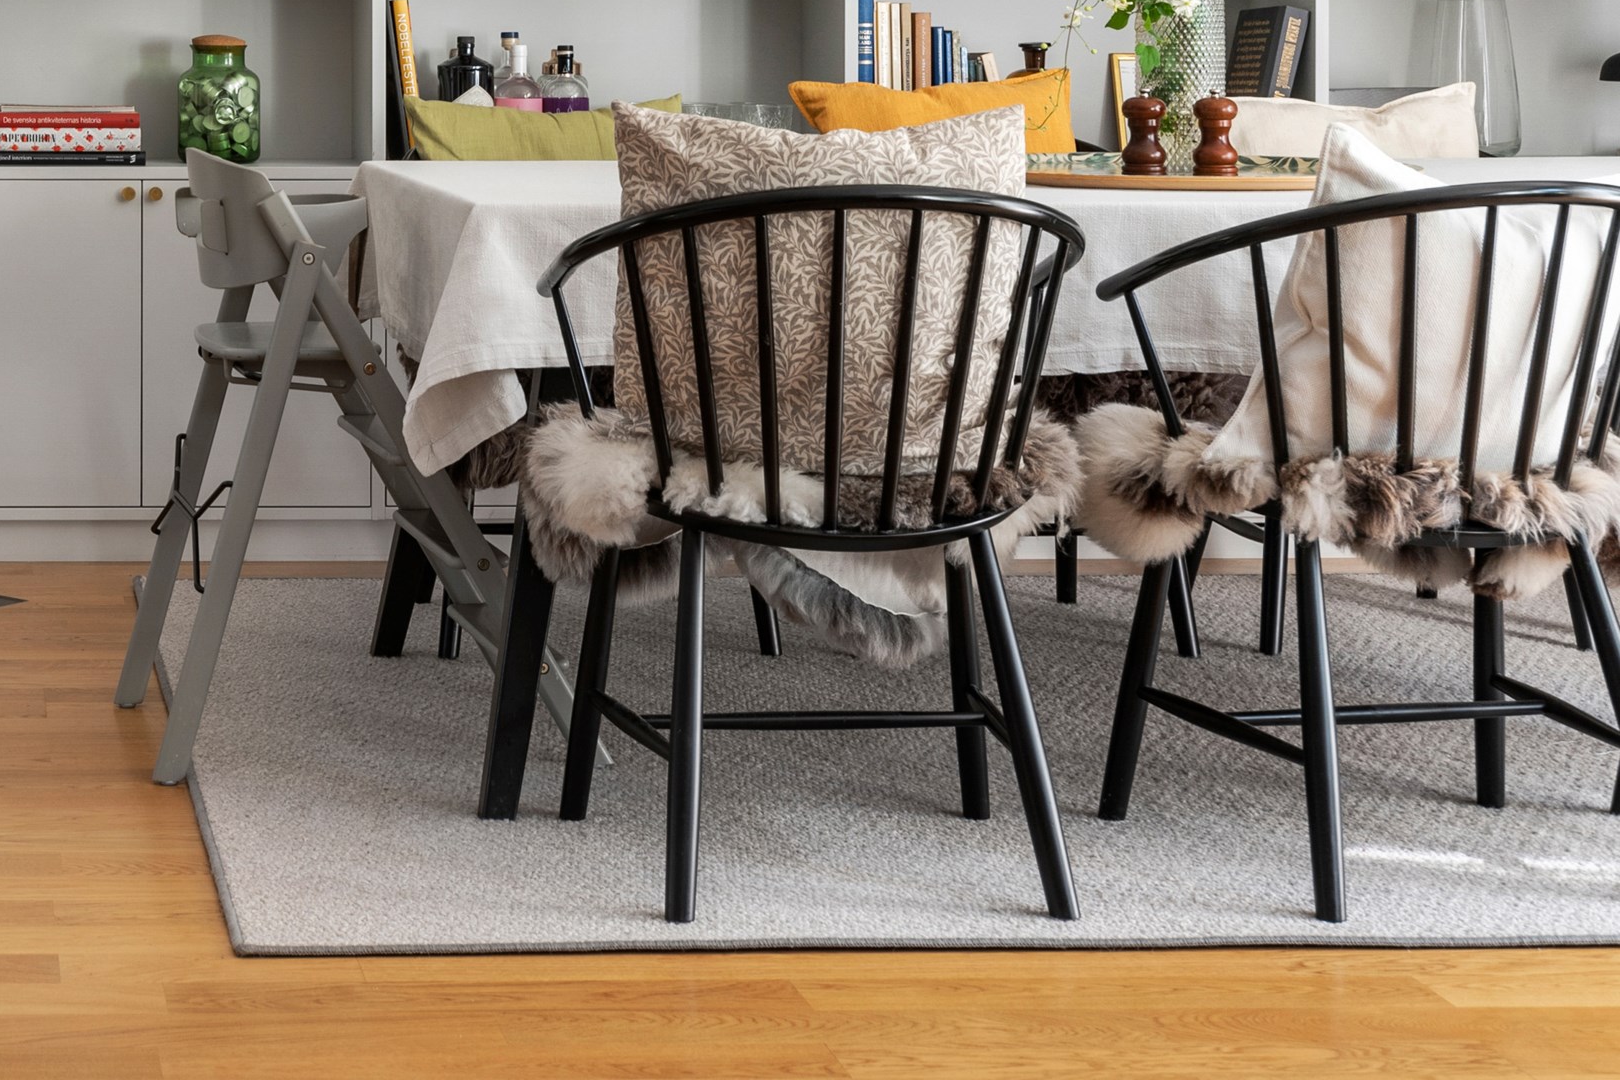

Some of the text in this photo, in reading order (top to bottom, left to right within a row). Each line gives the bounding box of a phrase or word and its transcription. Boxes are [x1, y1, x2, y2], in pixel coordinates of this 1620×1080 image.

[397, 13, 415, 97] NOBELFESTE
[3, 116, 102, 124] De svenska antikviteternas historia
